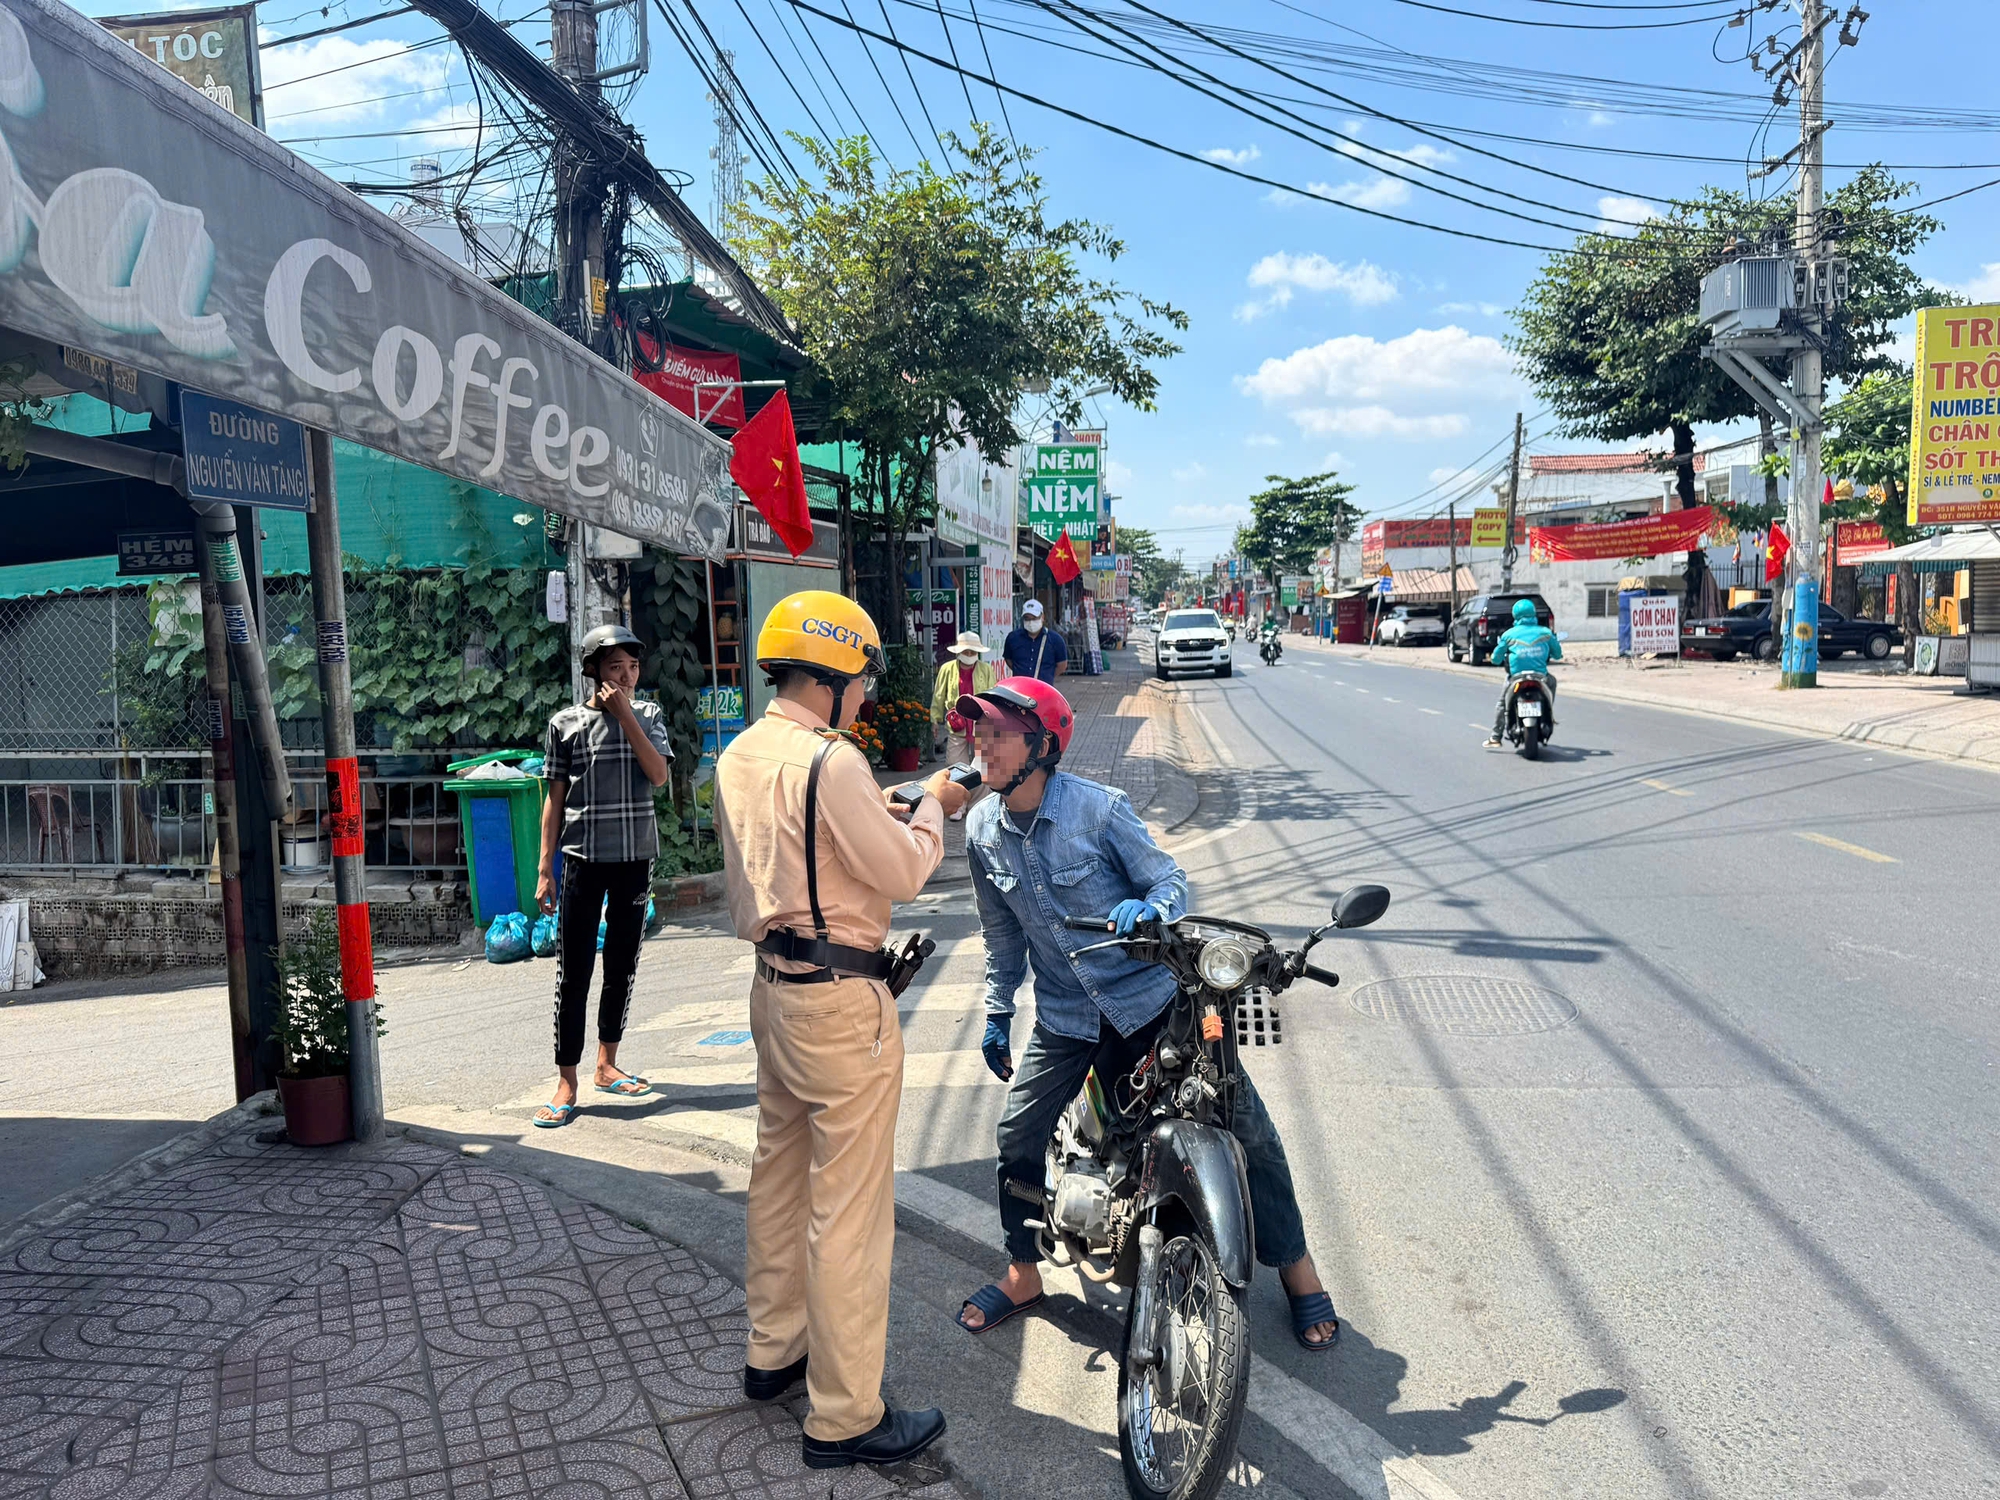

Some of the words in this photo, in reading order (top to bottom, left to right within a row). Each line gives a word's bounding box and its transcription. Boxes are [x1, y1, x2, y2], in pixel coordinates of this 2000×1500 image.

[148, 26, 225, 63] TÓC
[1945, 318, 2000, 348] TR
[265, 237, 611, 497] Coffee
[1930, 397, 2000, 418] NUMBE
[208, 411, 279, 445] ĐƯỜNG
[1928, 420, 1990, 442] CHÂN
[1040, 449, 1094, 474] NỆM
[1925, 445, 1968, 470] SỐT
[190, 448, 242, 490] NGUYỄN
[243, 456, 271, 494] VĂN
[272, 461, 303, 498] TĂNG
[1030, 479, 1096, 518] NỆM
[1474, 512, 1506, 520] PHOTO
[122, 536, 193, 554] HẺM
[126, 553, 194, 568] 348
[967, 566, 978, 578] SẢ
[932, 606, 954, 624] BÒ
[1632, 608, 1652, 627] CƠM
[1654, 608, 1676, 626] CHAY
[802, 618, 862, 650] CSGT
